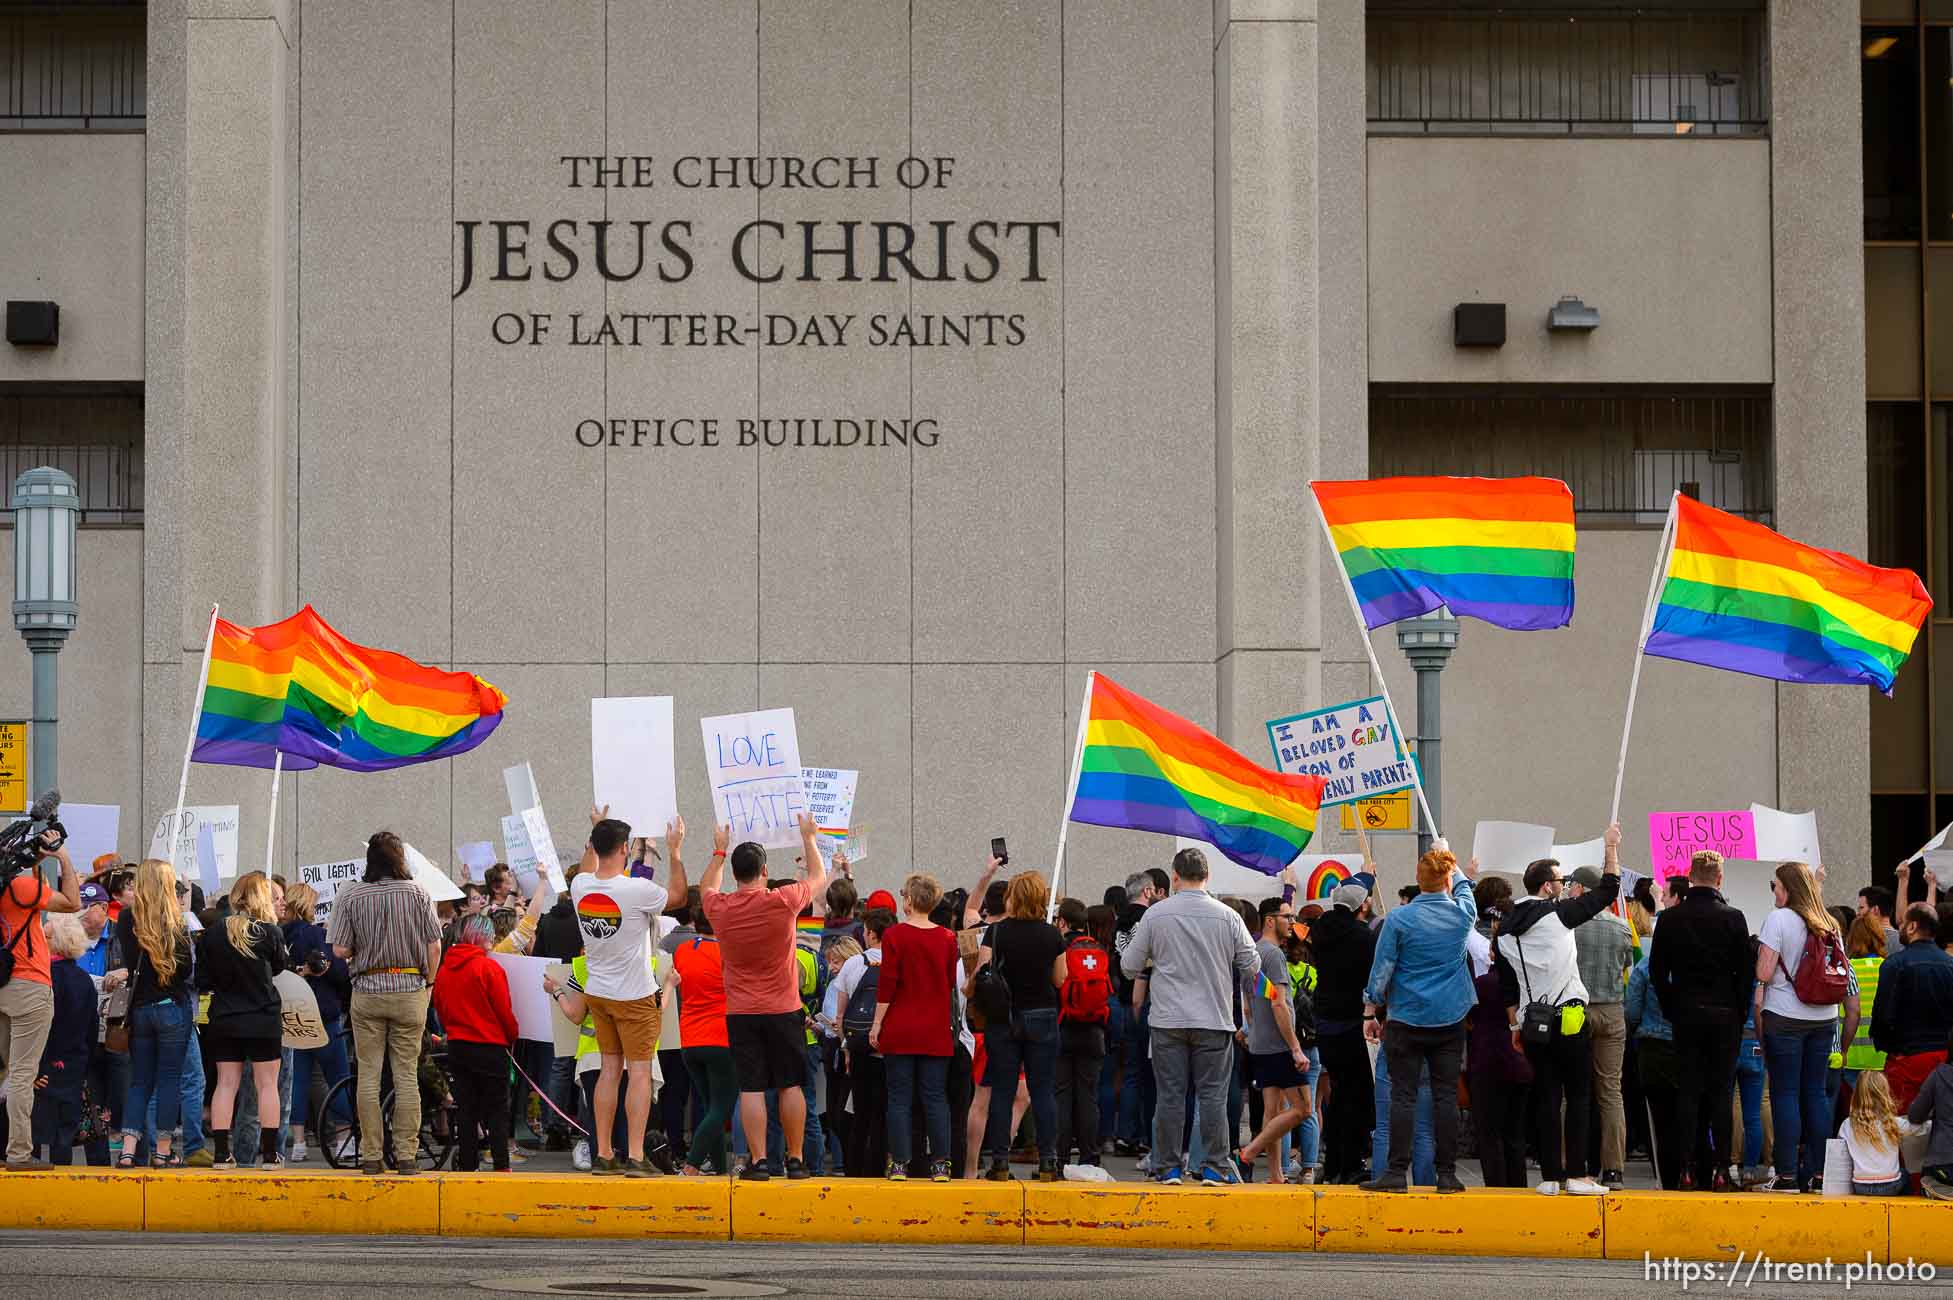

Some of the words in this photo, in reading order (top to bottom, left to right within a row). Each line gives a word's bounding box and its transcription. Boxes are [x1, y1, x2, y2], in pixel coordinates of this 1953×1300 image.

[561, 156, 654, 189] THE
[673, 155, 879, 190] CHURCH
[896, 156, 955, 189] OF
[452, 219, 695, 299] JESUS
[731, 219, 1061, 284] CHRIST
[491, 312, 551, 346] OF
[568, 313, 856, 347] LATTER-DAY
[868, 313, 1027, 347] SAINTS
[575, 418, 719, 448] OFFICE
[736, 418, 940, 448] BUILDING
[1276, 724, 1294, 742] I
[1312, 713, 1341, 734] AM
[1358, 704, 1374, 723] A
[716, 732, 785, 769] LOVE
[1281, 734, 1346, 764] BELOVED
[1351, 723, 1388, 747] GAY
[1298, 760, 1332, 777] SON
[1338, 751, 1356, 771] OF
[1322, 775, 1356, 801] ENLY
[156, 810, 195, 839] STOP
[725, 790, 803, 833] HATE
[1660, 814, 1744, 843] JESUS
[303, 866, 322, 884] BYU
